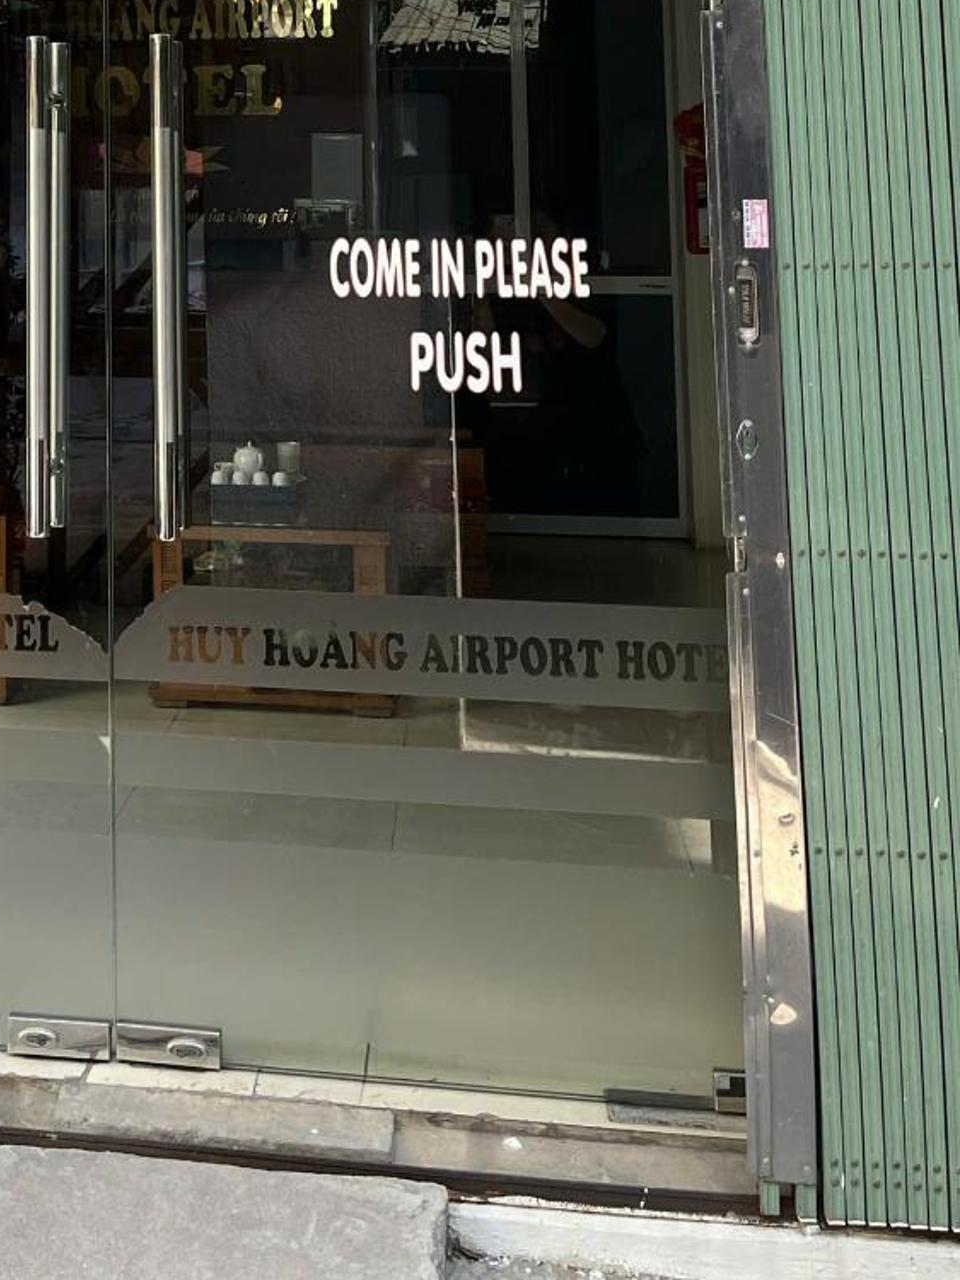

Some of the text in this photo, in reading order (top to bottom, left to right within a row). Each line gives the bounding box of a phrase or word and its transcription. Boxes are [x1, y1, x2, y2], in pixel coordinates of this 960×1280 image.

[330, 237, 591, 298] COME IN PLEASE
[410, 330, 523, 393] PUSH
[167, 625, 251, 665] HUY
[262, 621, 408, 671] HOÀNG
[420, 634, 604, 680] AIRPORT
